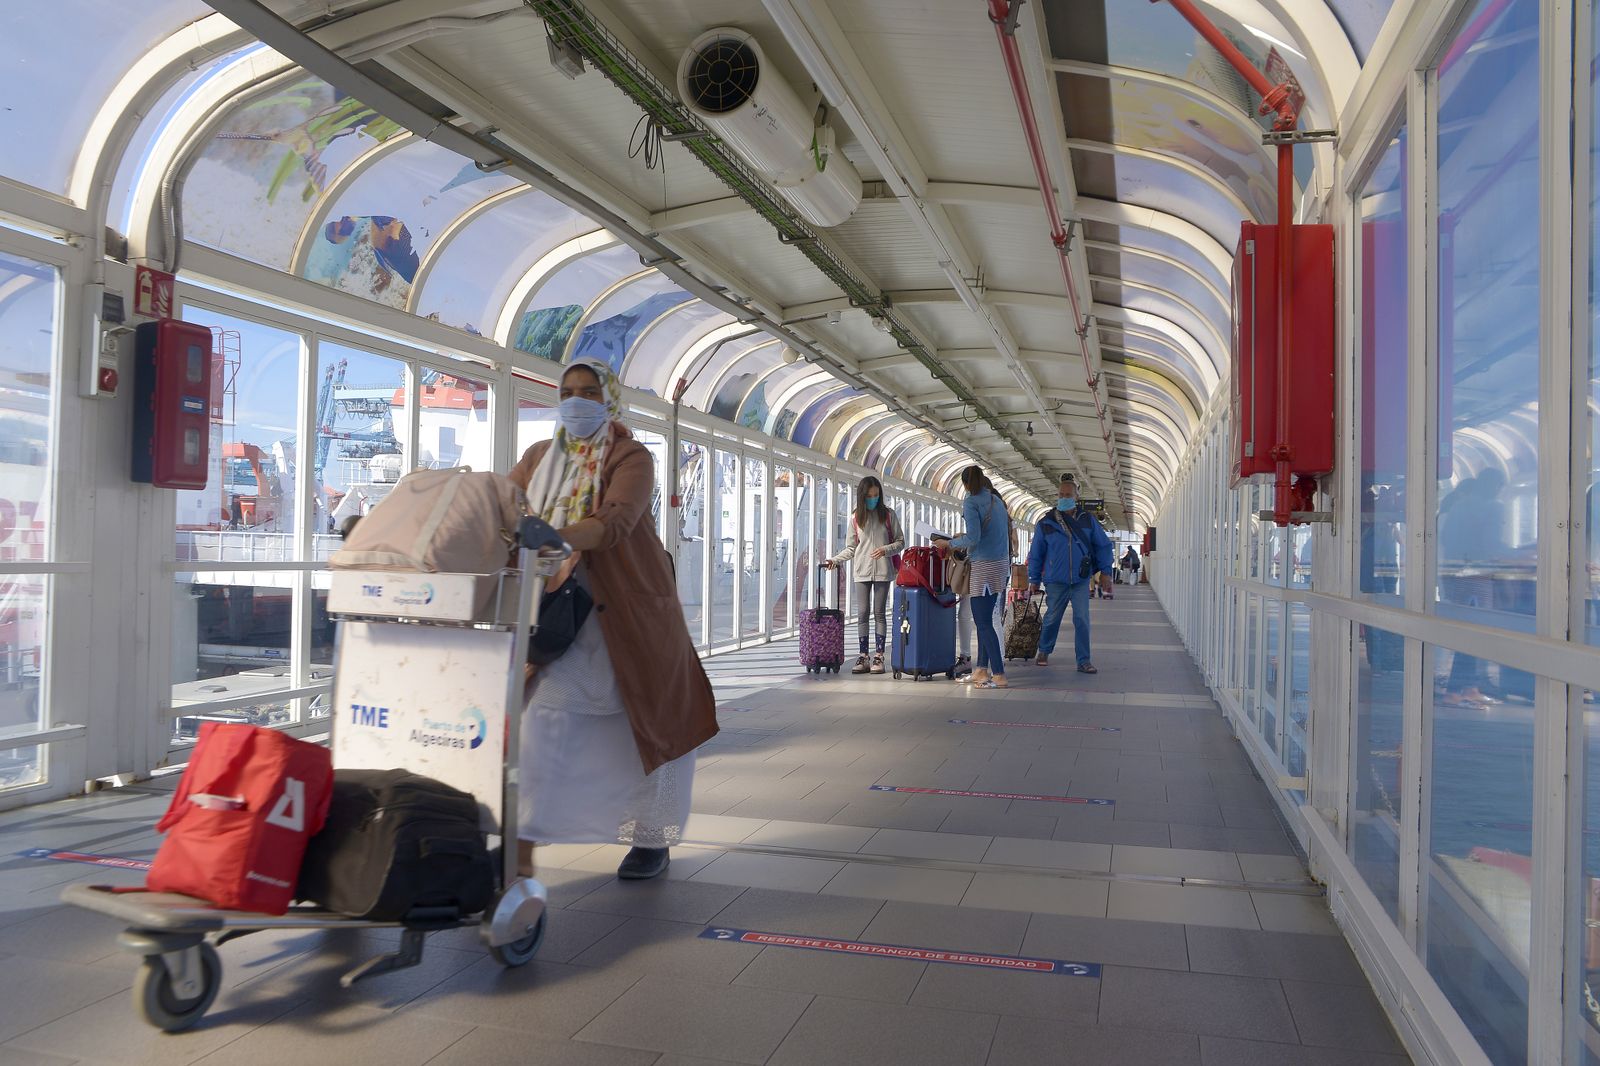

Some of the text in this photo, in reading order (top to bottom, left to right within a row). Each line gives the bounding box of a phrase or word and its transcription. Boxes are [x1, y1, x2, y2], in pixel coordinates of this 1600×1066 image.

[362, 585, 383, 597] TME
[351, 704, 389, 728] TME
[408, 729, 466, 749] Algeciras
[757, 935, 821, 947] RESPETE
[846, 944, 921, 957] DISTANCIA
[925, 952, 945, 960] DE
[949, 954, 1037, 968] SEGURIDAD
